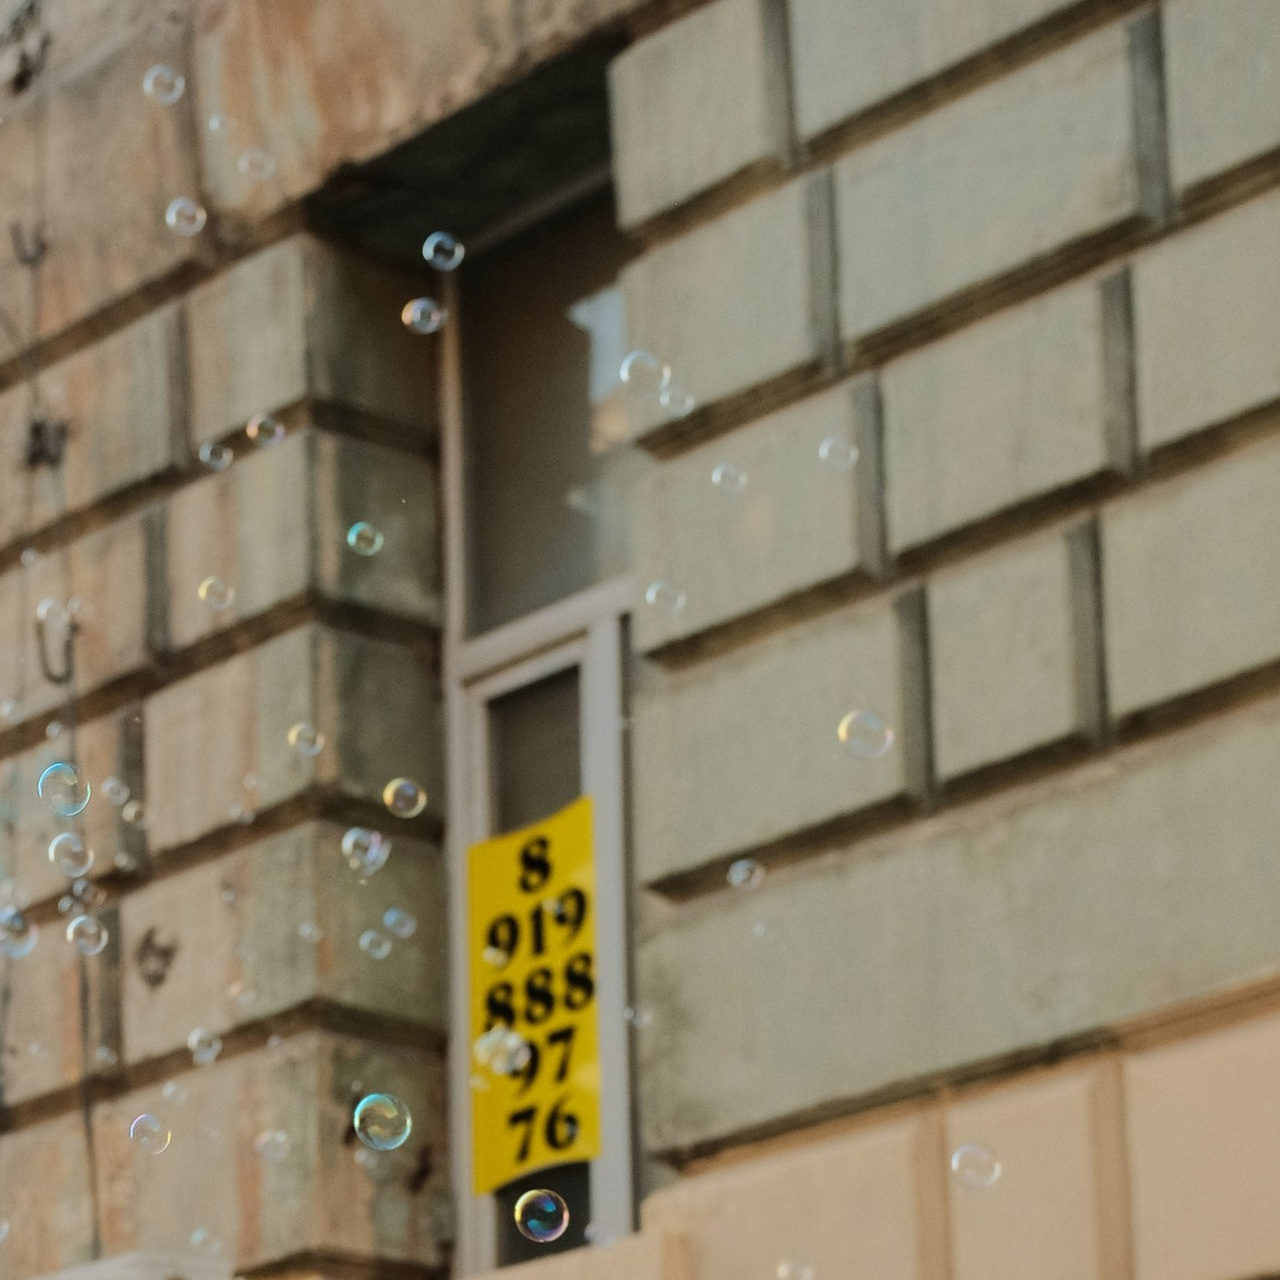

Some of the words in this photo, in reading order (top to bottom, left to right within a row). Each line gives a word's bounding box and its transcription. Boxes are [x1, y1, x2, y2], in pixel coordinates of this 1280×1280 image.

[517, 836, 552, 894] 8
[484, 887, 587, 972] 919
[484, 952, 594, 1036] 888
[507, 1096, 580, 1165] 76
